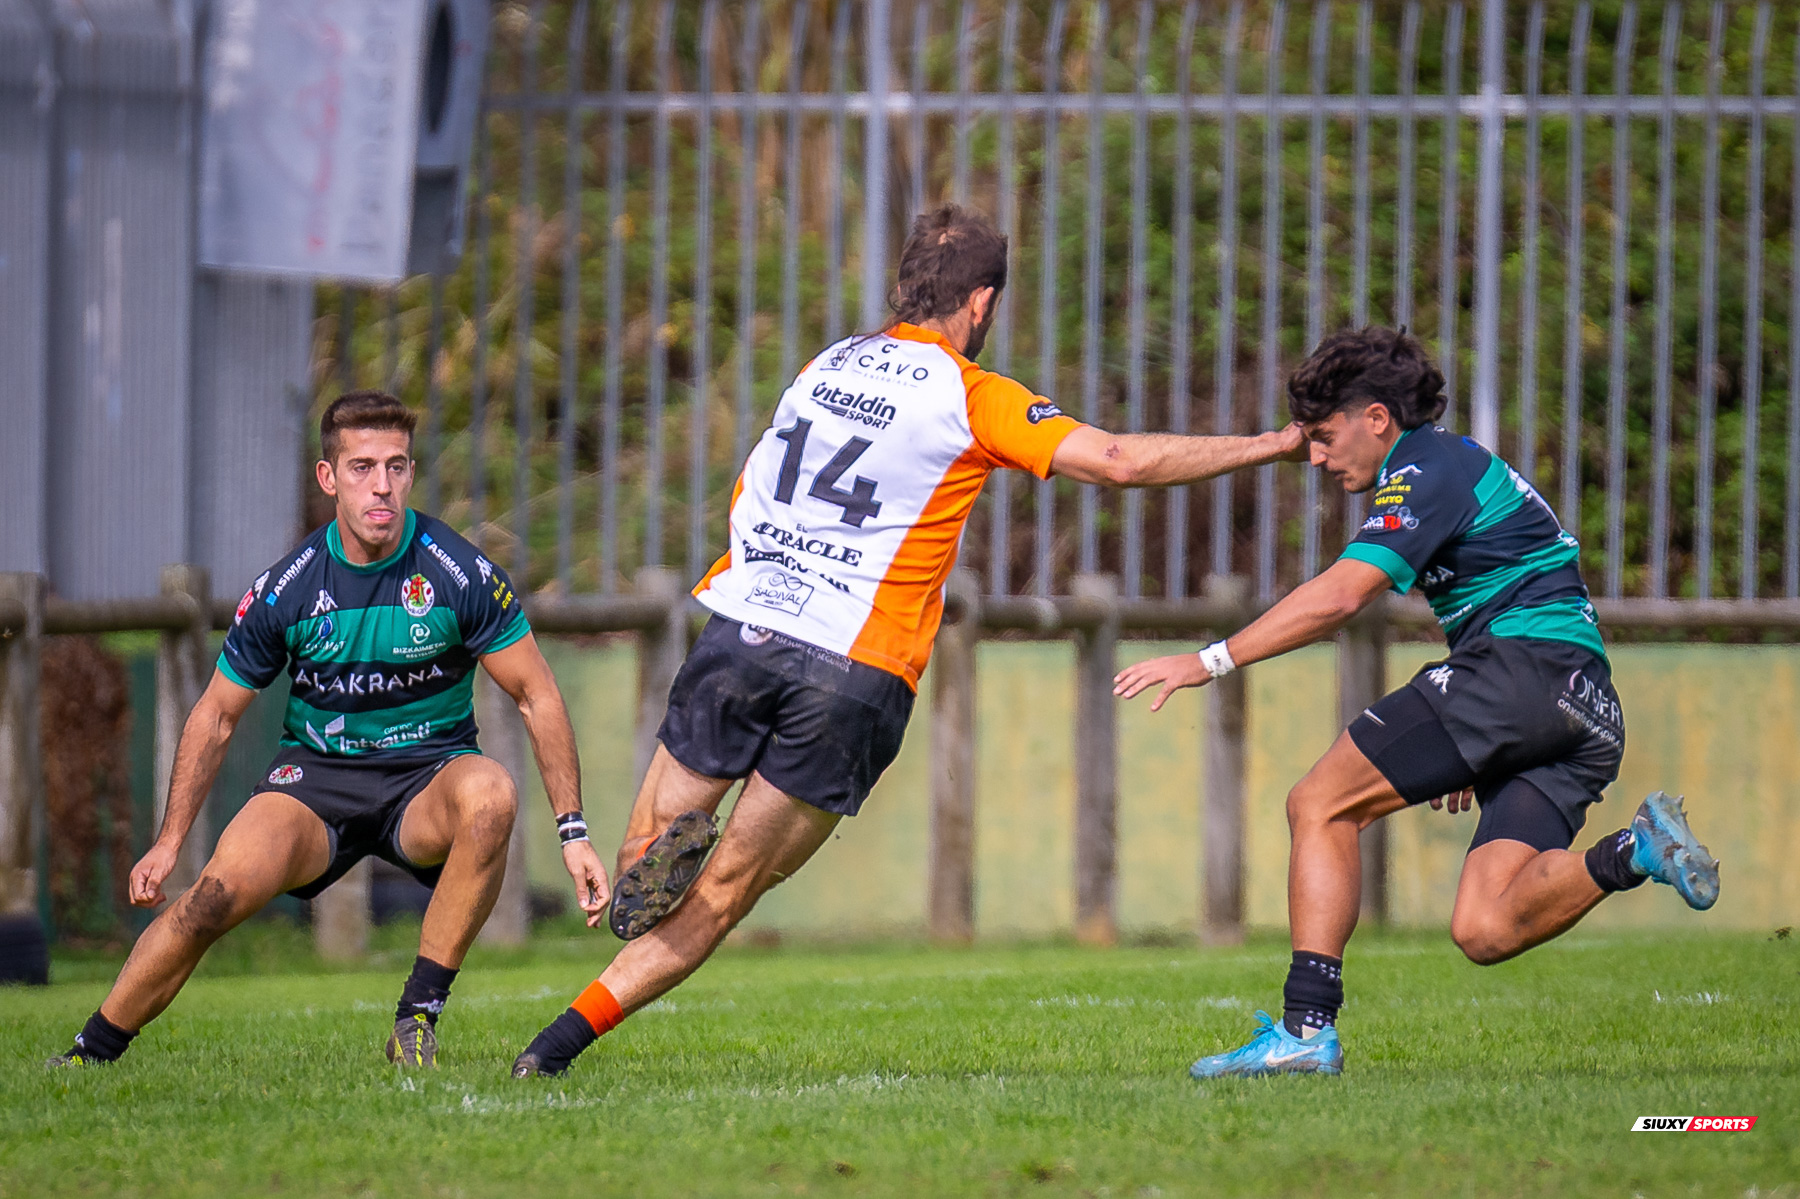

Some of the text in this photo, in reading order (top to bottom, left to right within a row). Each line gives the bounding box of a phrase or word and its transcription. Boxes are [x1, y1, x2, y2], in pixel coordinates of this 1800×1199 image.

[858, 354, 929, 381] CAVO
[846, 410, 892, 430] SPORT
[774, 416, 883, 529] 14
[796, 523, 809, 533] EL
[273, 546, 316, 597] ASIMAIR
[427, 542, 470, 588] ASIMAIR
[295, 663, 444, 696] ALAKRANA
